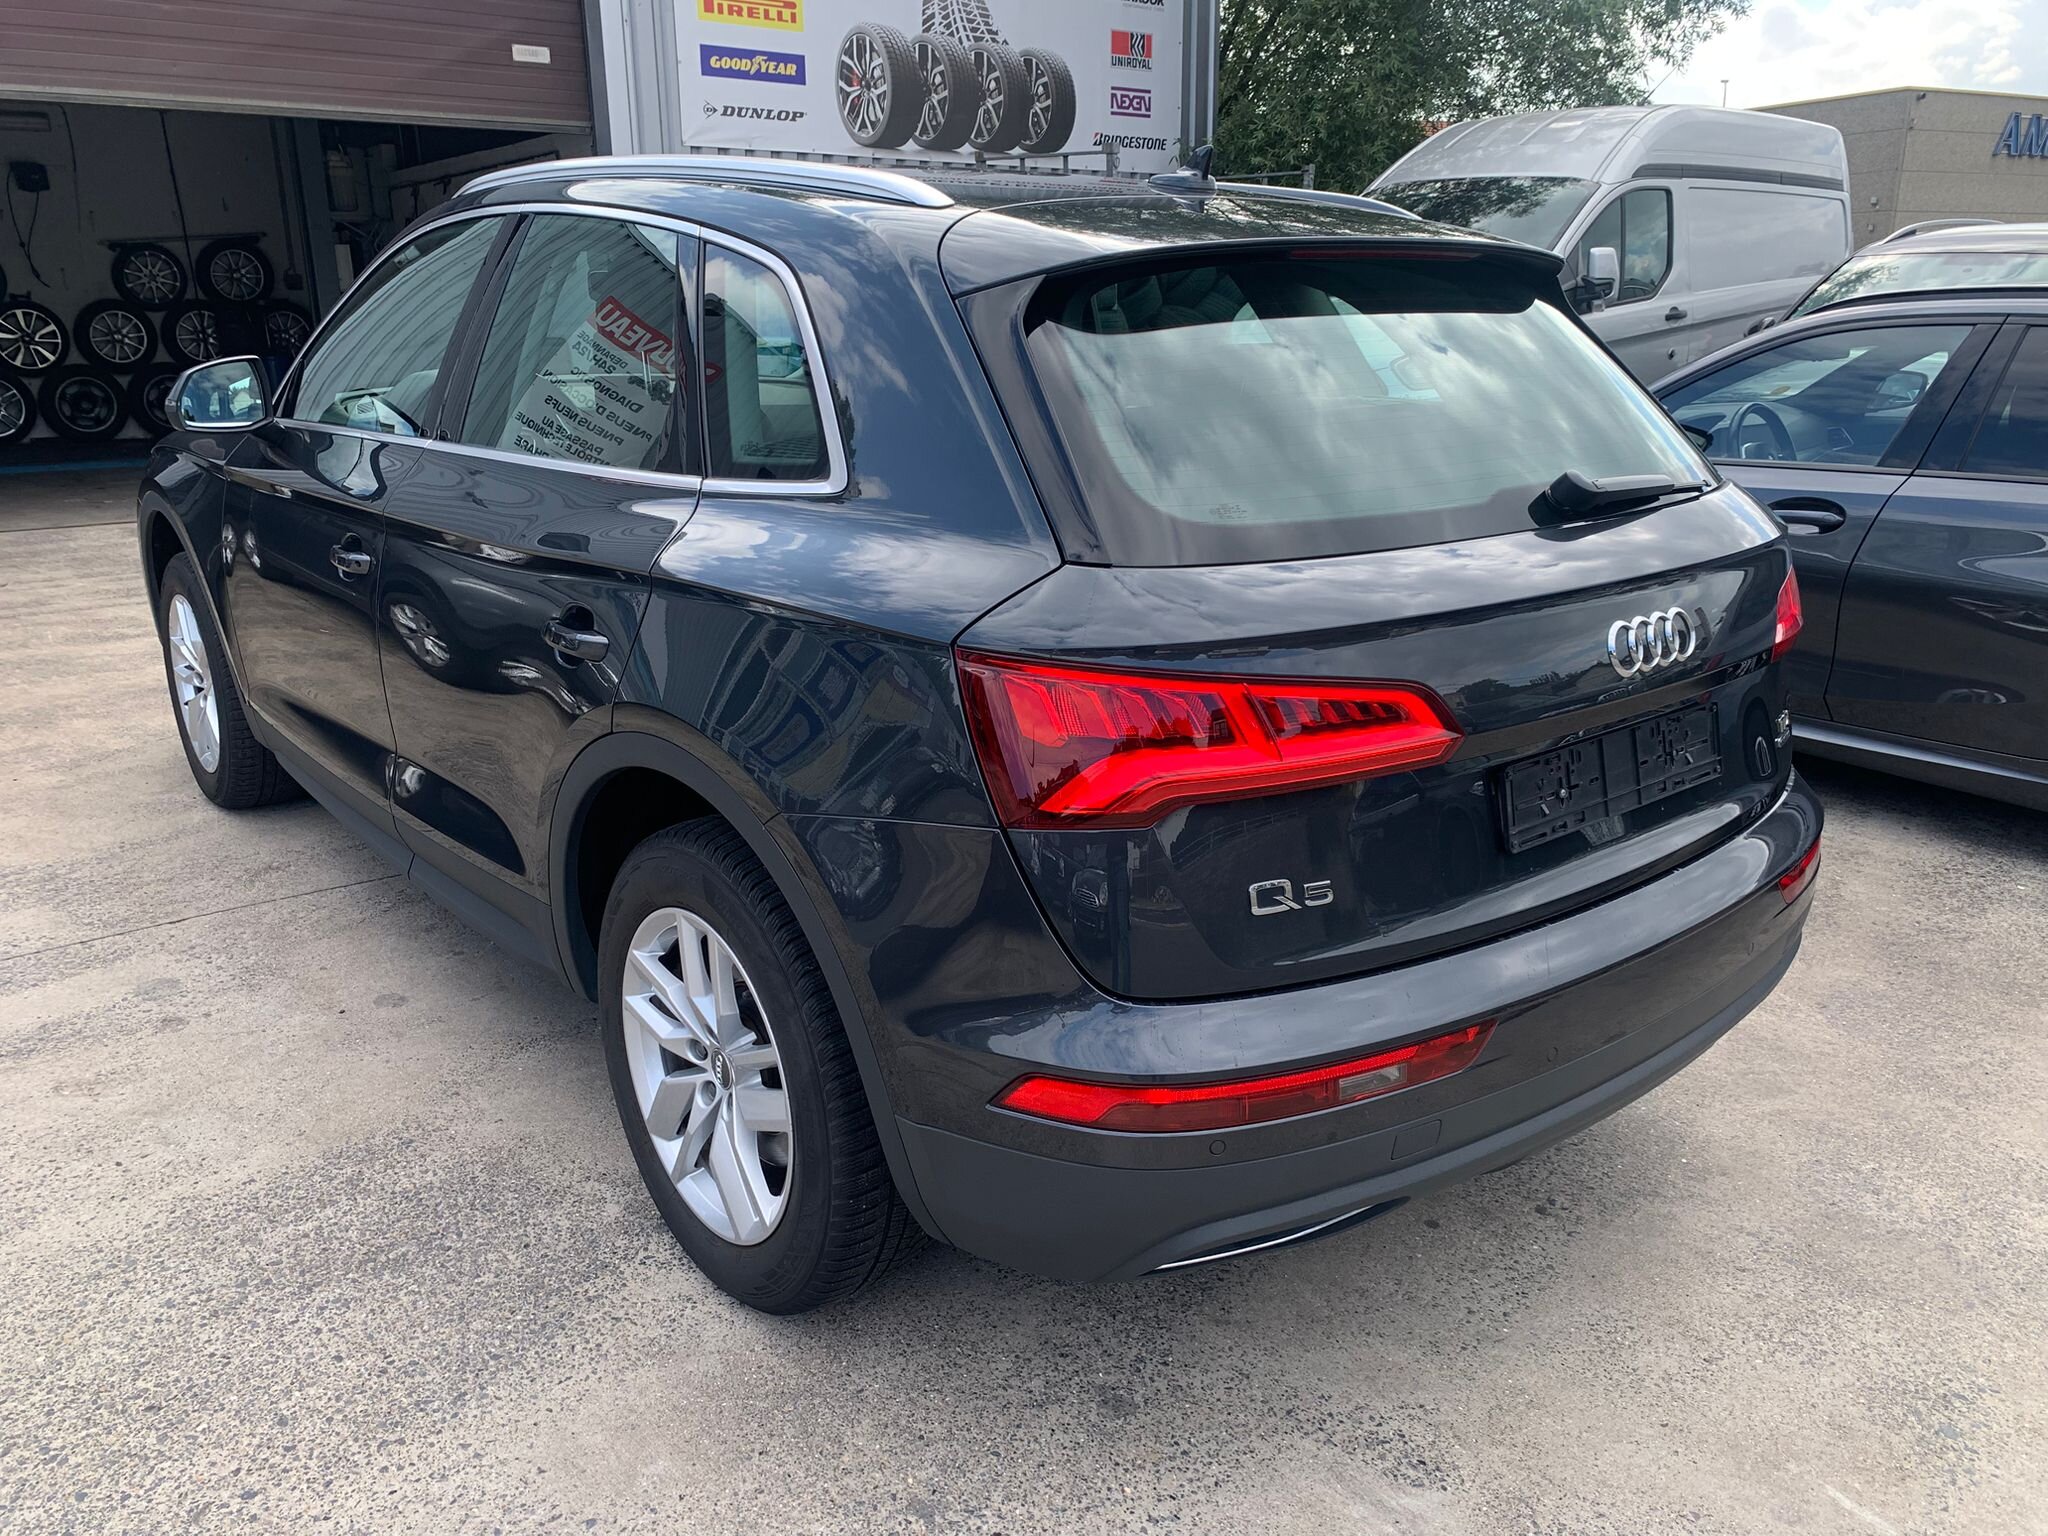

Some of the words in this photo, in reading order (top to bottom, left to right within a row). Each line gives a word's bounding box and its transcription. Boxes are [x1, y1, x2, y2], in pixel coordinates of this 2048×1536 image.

[704, 0, 797, 24] PIRELLI
[710, 55, 797, 76] GOODYEAR
[1111, 55, 1152, 70] UNIROYAL
[1111, 92, 1151, 113] NEXEN
[720, 105, 805, 122] DUNLOP
[1092, 132, 1167, 151] BRIDGESTONE
[1249, 879, 1334, 916] Q5
